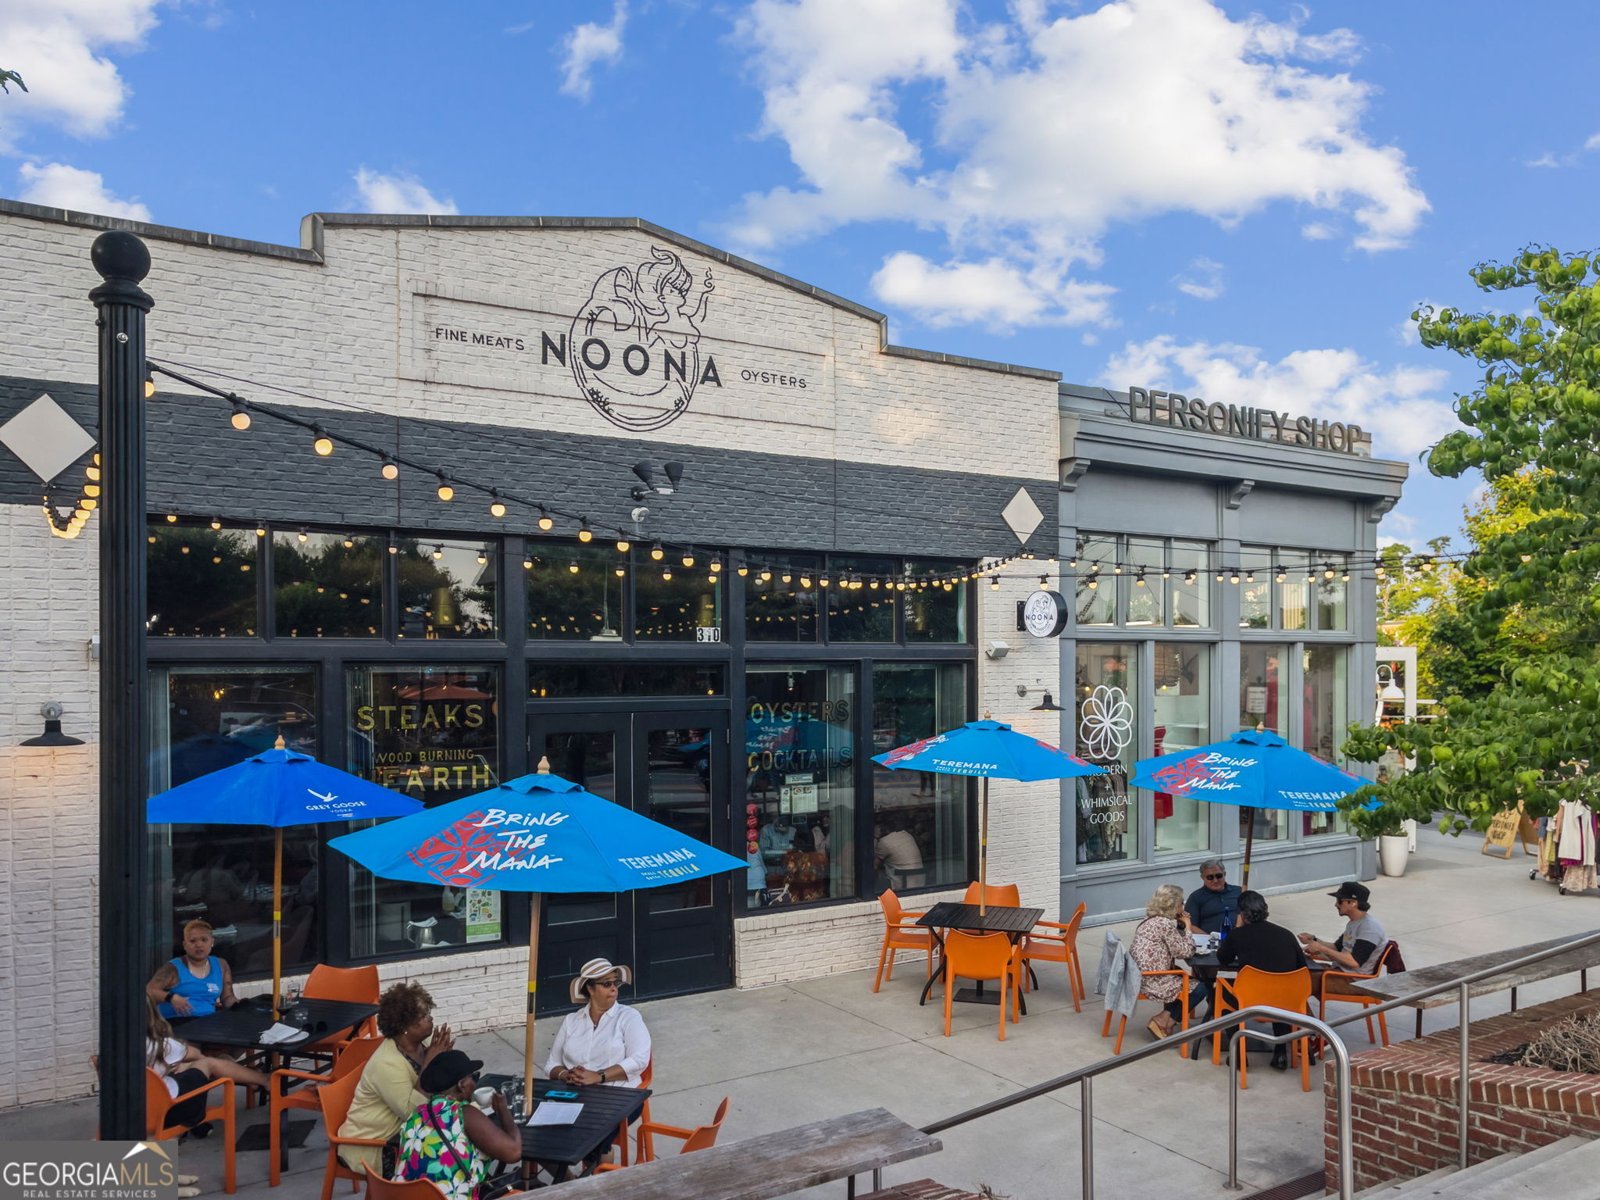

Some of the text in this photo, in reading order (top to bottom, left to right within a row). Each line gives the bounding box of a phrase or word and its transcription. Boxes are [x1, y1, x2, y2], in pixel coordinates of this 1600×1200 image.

[435, 327, 525, 351] FINE MEATS
[541, 330, 723, 388] NOONA
[741, 369, 807, 388] OYSTERS
[1129, 386, 1363, 454] PERSONIFY SHOP
[356, 703, 484, 731] STEAKS
[751, 700, 850, 724] OYSTERS
[374, 750, 474, 764] WOOD BURNING
[748, 747, 853, 772] COCKTAILS
[932, 758, 999, 770] TEREMANA
[1081, 795, 1133, 809] WHIMSICAL
[1278, 790, 1347, 800] TEREMANA
[305, 801, 368, 811] GREY GOOSE
[1090, 811, 1125, 825] GOODS
[618, 847, 697, 870] TEREMANA
[657, 863, 700, 878] TEQUILA
